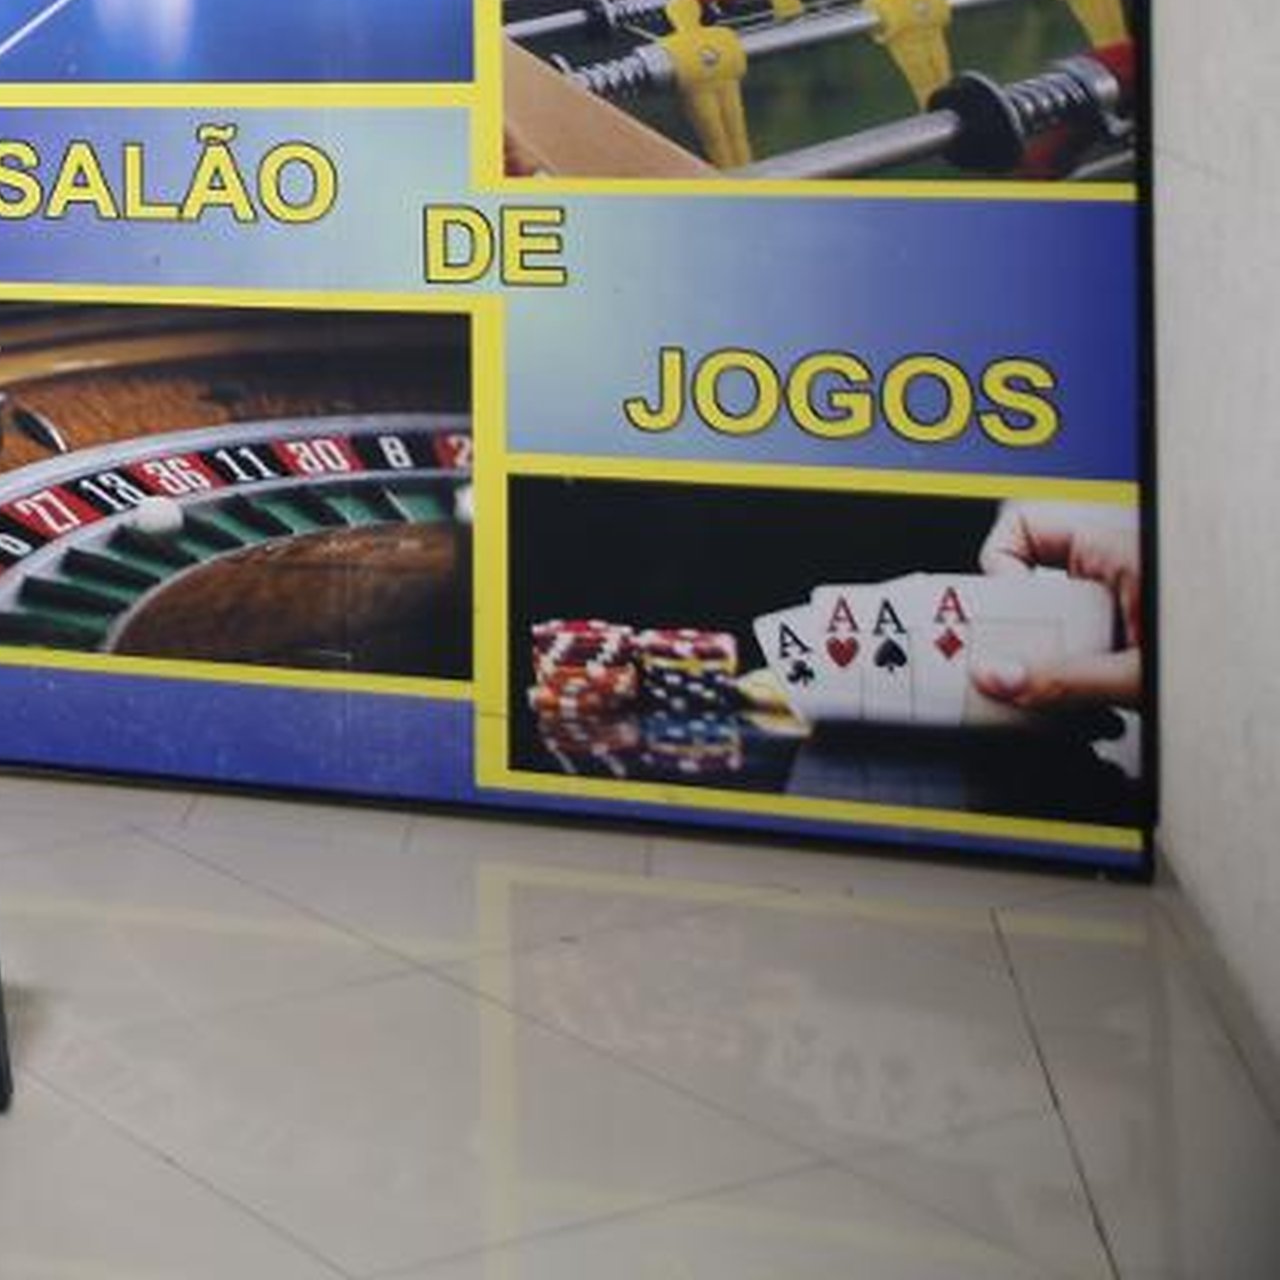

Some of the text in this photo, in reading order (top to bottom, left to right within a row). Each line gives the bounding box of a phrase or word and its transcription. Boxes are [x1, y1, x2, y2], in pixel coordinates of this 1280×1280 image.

[422, 204, 568, 285] DE
[623, 346, 1060, 448] JOGOS
[14, 490, 81, 533] 27
[81, 472, 145, 511] 13
[142, 457, 211, 495] 36
[216, 447, 277, 481] 11
[285, 439, 351, 472] 30
[378, 436, 414, 468] 8
[779, 585, 965, 658] A A A A
